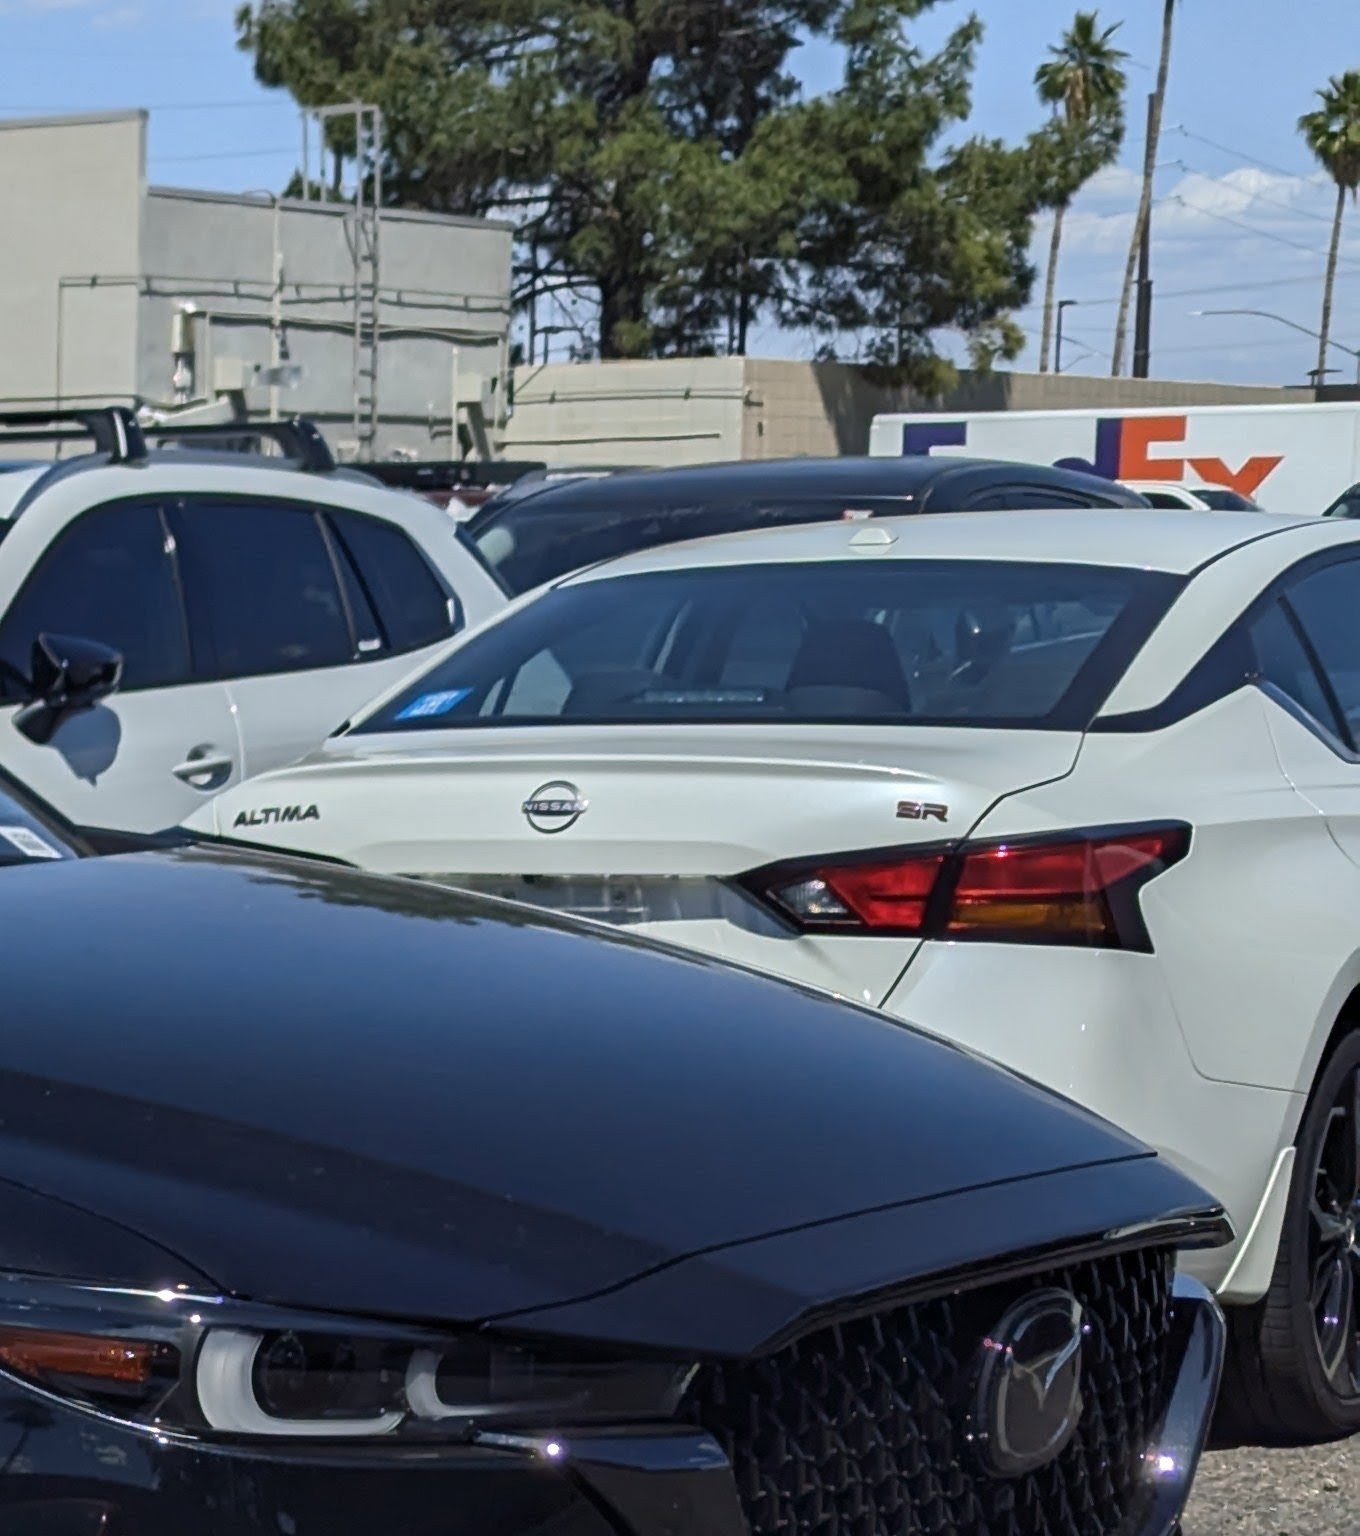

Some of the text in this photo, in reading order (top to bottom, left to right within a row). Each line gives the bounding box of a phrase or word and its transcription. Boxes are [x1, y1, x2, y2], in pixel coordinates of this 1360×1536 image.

[903, 415, 1285, 501] FdEx
[233, 804, 320, 828] ALTIMA
[523, 801, 585, 812] NISSAN
[896, 800, 948, 822] SR
